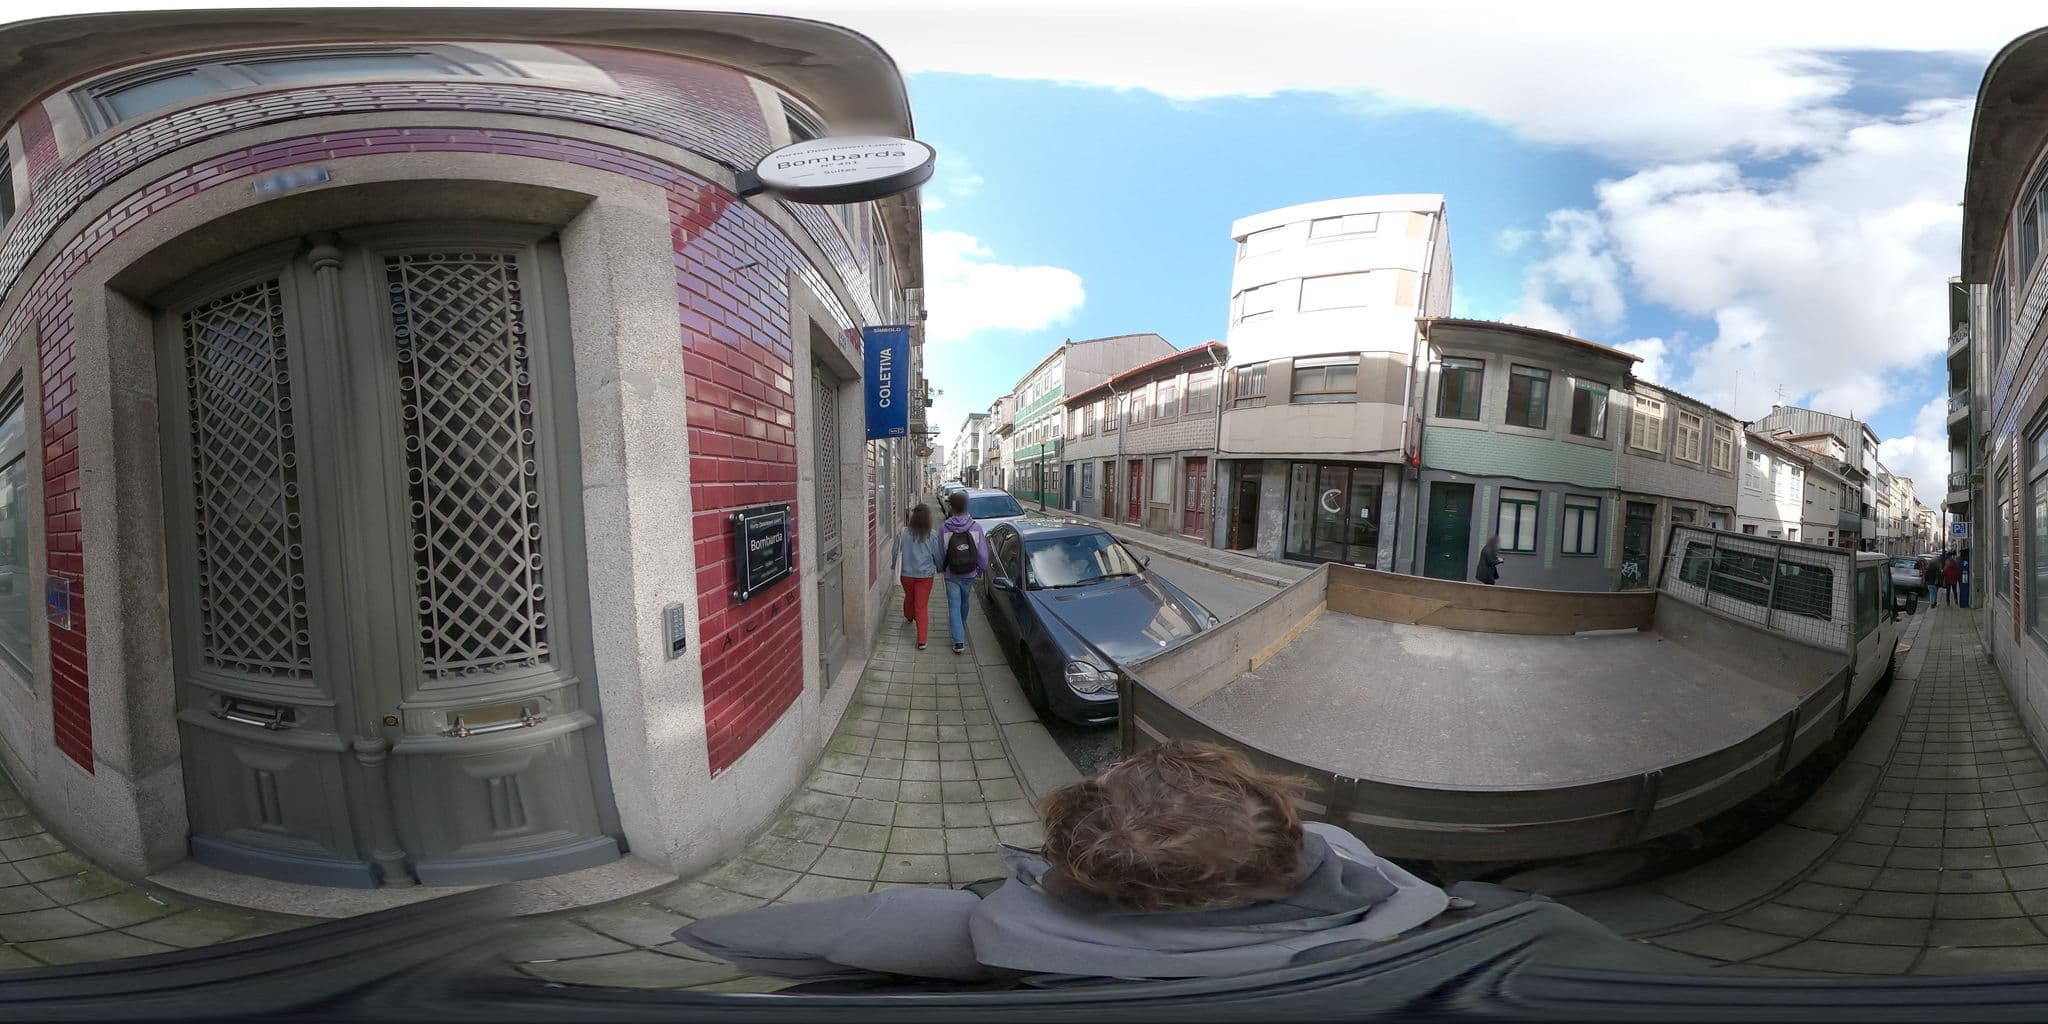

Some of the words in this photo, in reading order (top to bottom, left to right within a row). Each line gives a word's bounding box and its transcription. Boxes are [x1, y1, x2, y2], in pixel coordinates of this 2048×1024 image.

[778, 151, 905, 169] Bombarda
[879, 348, 892, 408] COLETIVA
[750, 533, 782, 551] Bombarda
